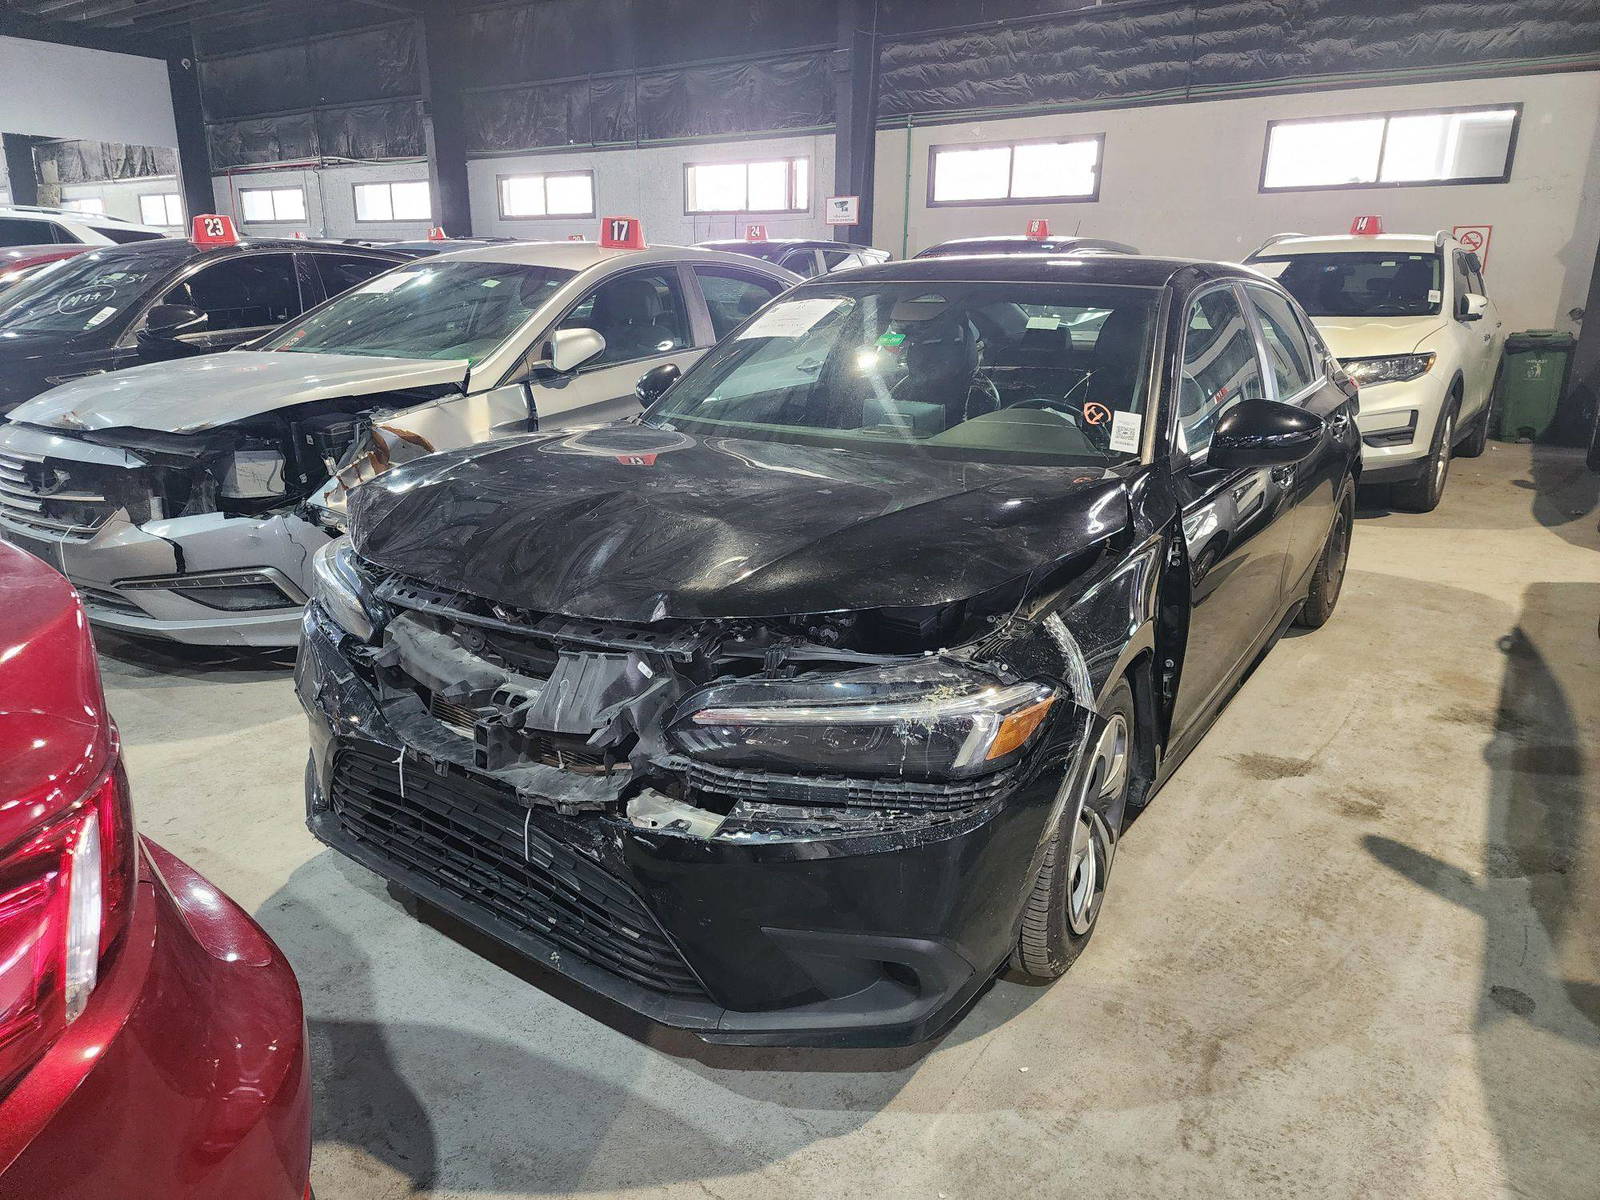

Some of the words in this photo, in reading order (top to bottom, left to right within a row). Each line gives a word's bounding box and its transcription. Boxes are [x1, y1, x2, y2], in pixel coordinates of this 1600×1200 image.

[204, 218, 224, 236] 23
[612, 220, 629, 241] 17
[751, 225, 760, 237] 24
[1356, 216, 1369, 231] 14
